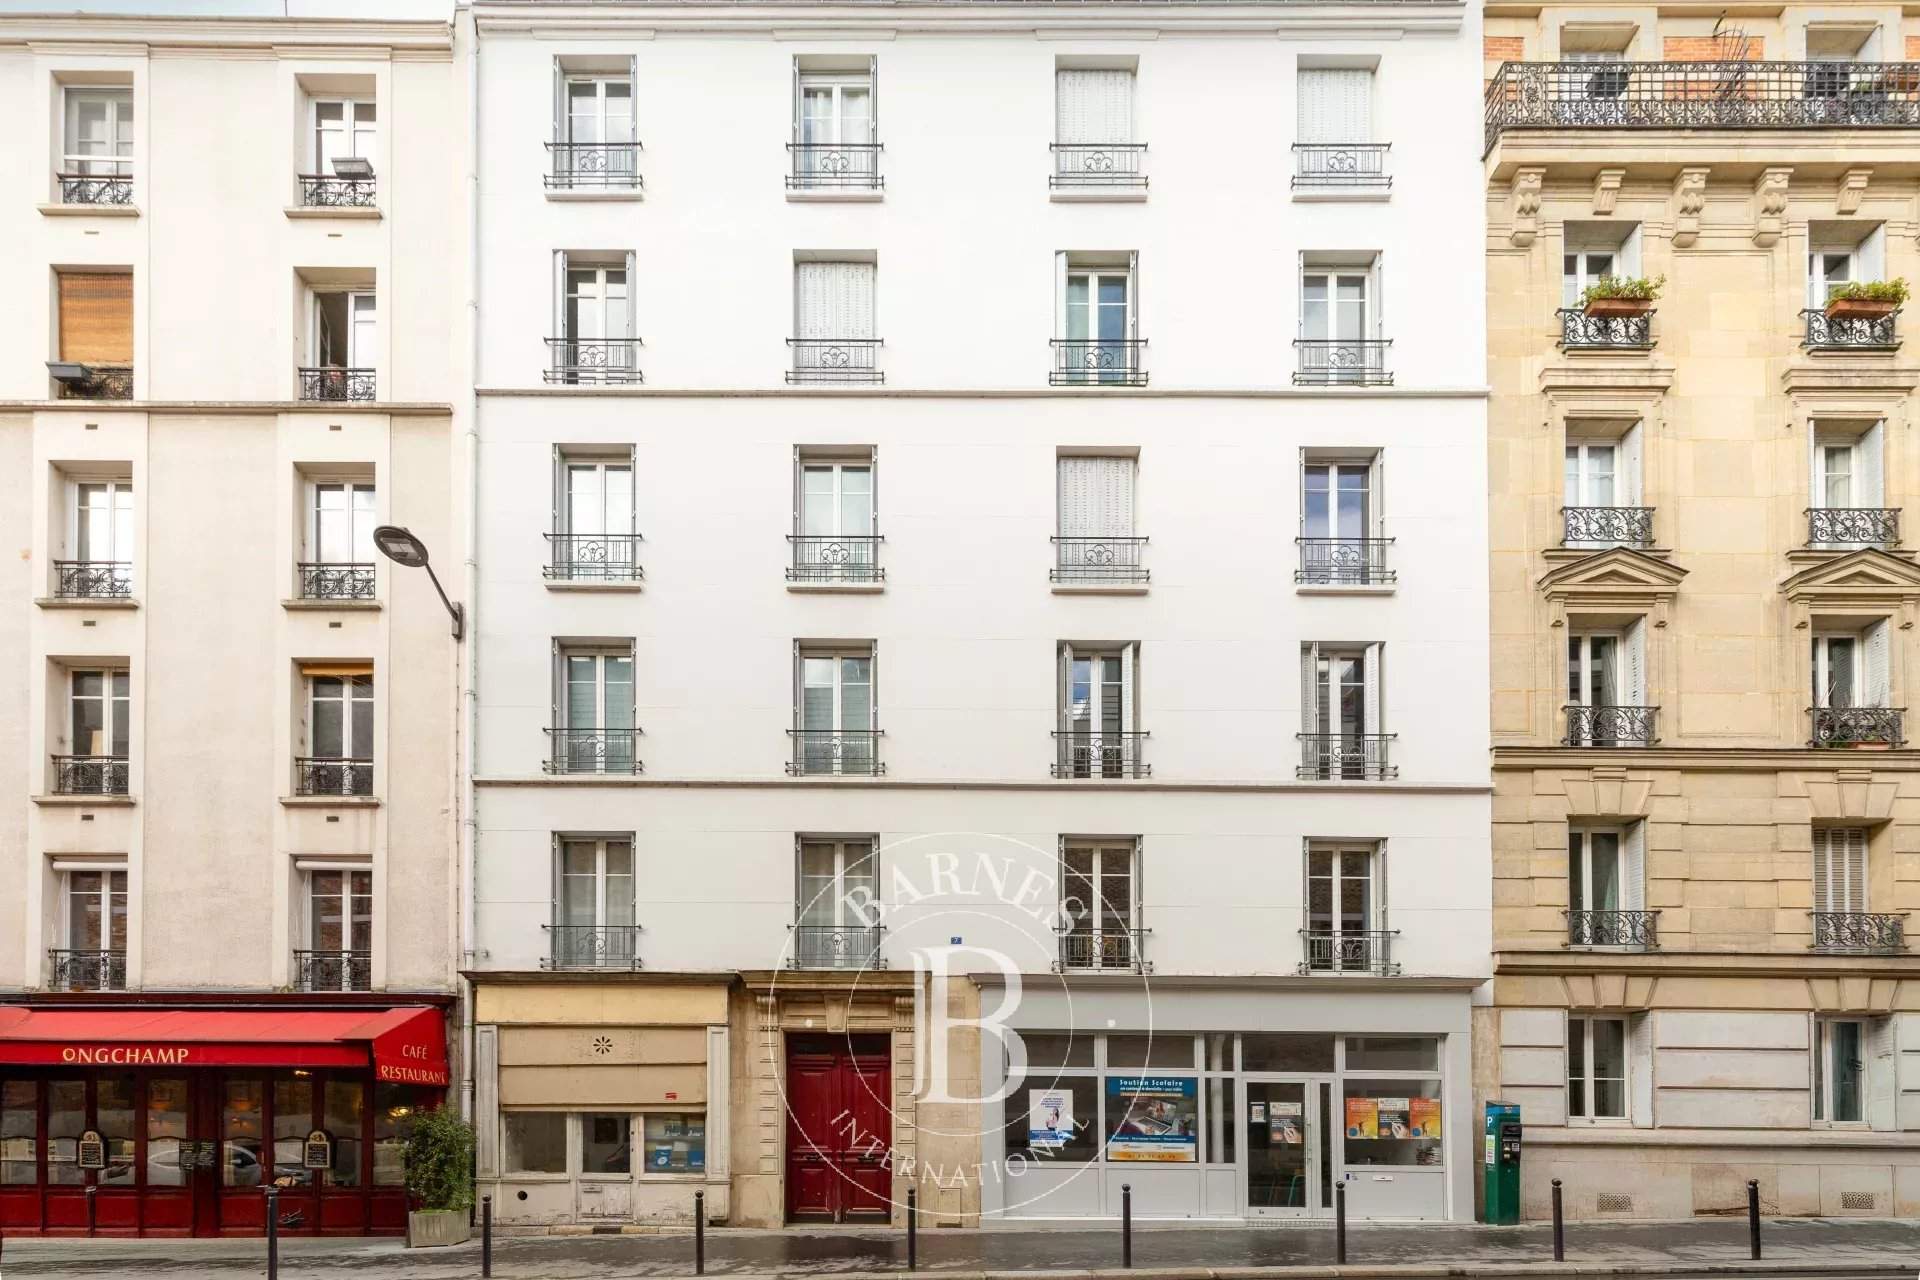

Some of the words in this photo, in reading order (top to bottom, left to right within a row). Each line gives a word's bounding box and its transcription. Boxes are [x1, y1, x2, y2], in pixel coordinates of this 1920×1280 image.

[62, 1047, 189, 1064] ONGCHAMP
[402, 1044, 428, 1060] CAFÉ
[381, 1064, 445, 1084] RESTAURANT
[1487, 1116, 1493, 1128] P
